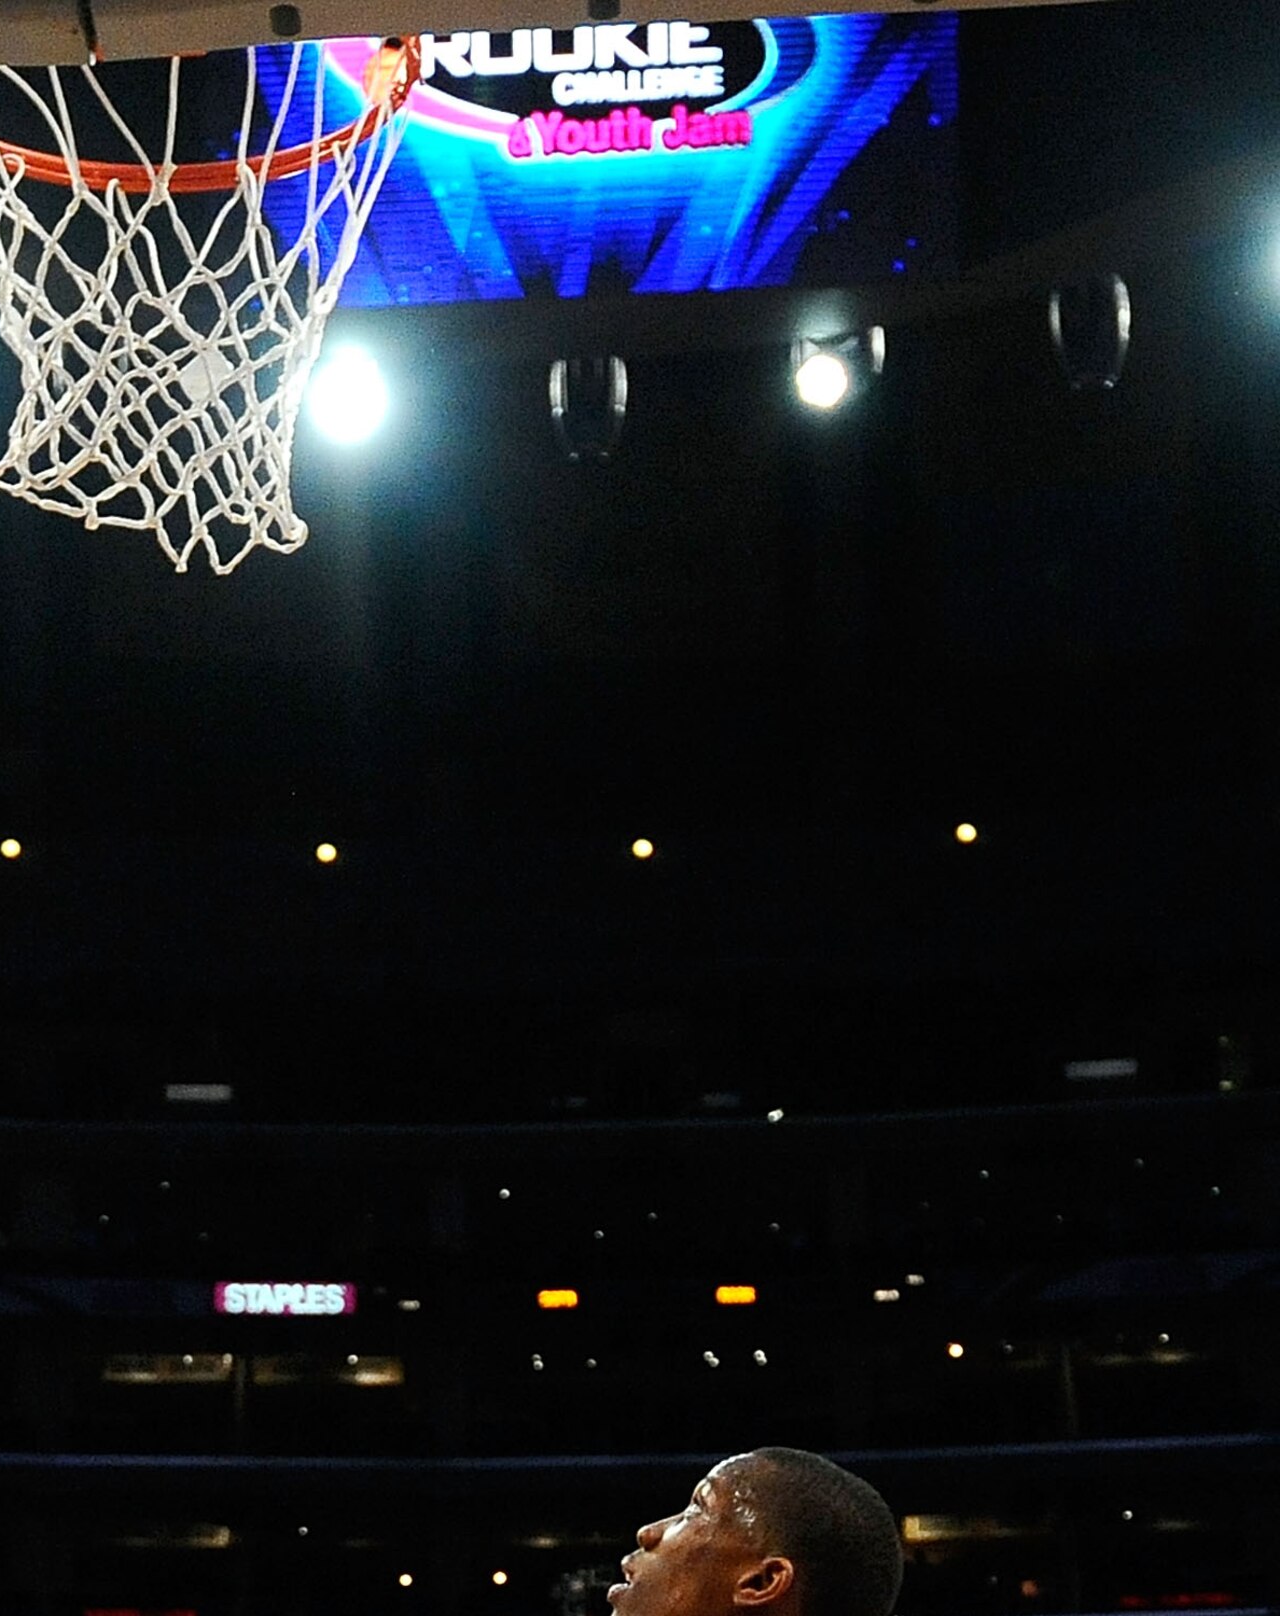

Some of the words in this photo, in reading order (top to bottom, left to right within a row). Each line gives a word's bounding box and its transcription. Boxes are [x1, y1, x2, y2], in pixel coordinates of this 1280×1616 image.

[551, 65, 725, 107] CHALLENGE
[530, 107, 652, 156] Youth
[662, 104, 752, 150] Jam
[223, 1283, 346, 1316] STAPLES
